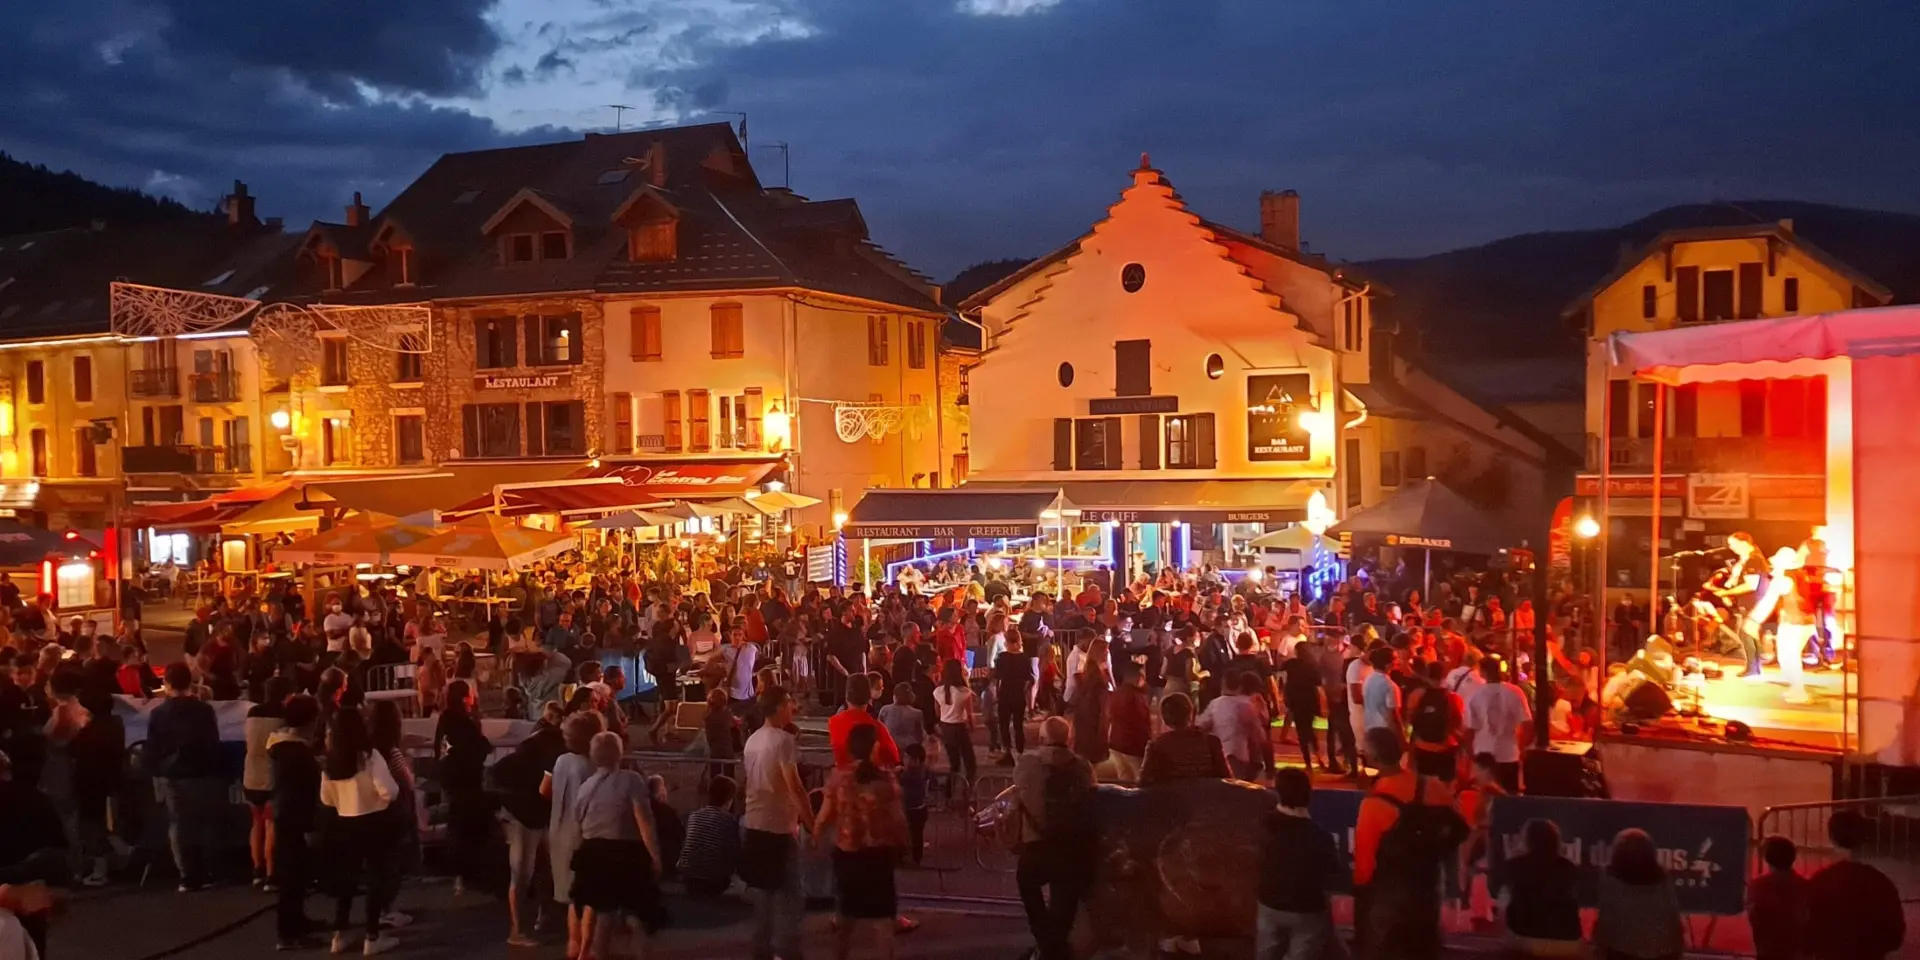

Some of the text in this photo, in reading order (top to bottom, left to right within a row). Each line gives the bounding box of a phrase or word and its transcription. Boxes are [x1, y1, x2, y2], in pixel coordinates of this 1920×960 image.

[1270, 438, 1287, 446] BAR
[1082, 511, 1138, 521] LE CLIFF
[1228, 513, 1270, 521] BURGERS
[856, 526, 1021, 537] RESTAURANT BAR CREPERIE
[1399, 535, 1451, 548] PAULANER
